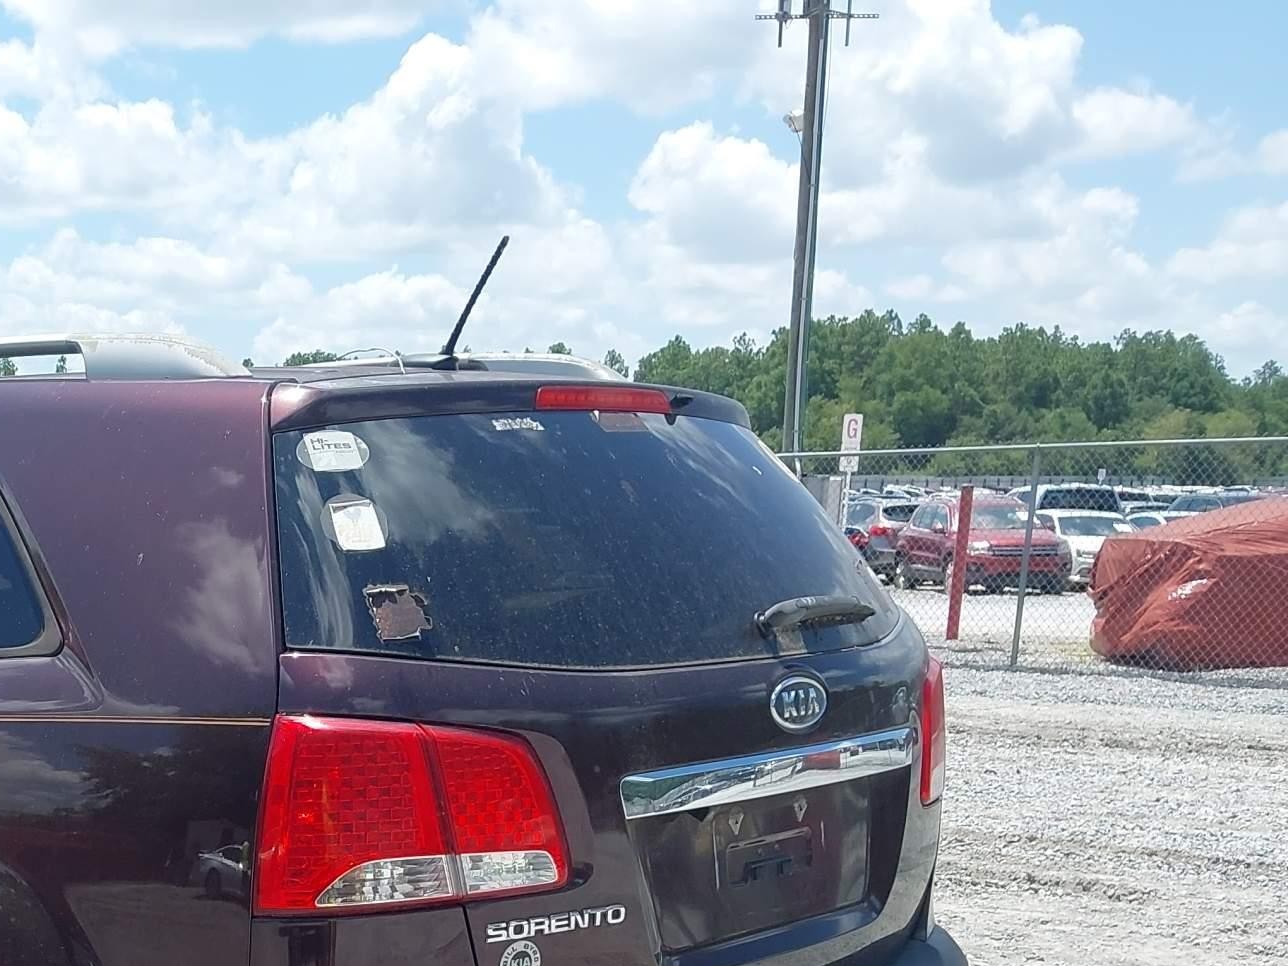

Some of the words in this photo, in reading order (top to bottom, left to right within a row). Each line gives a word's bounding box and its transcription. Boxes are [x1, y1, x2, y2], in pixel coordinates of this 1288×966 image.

[847, 418, 859, 439] G
[312, 442, 352, 451] LITES
[781, 687, 820, 719] KIA
[486, 904, 626, 943] SORENTO
